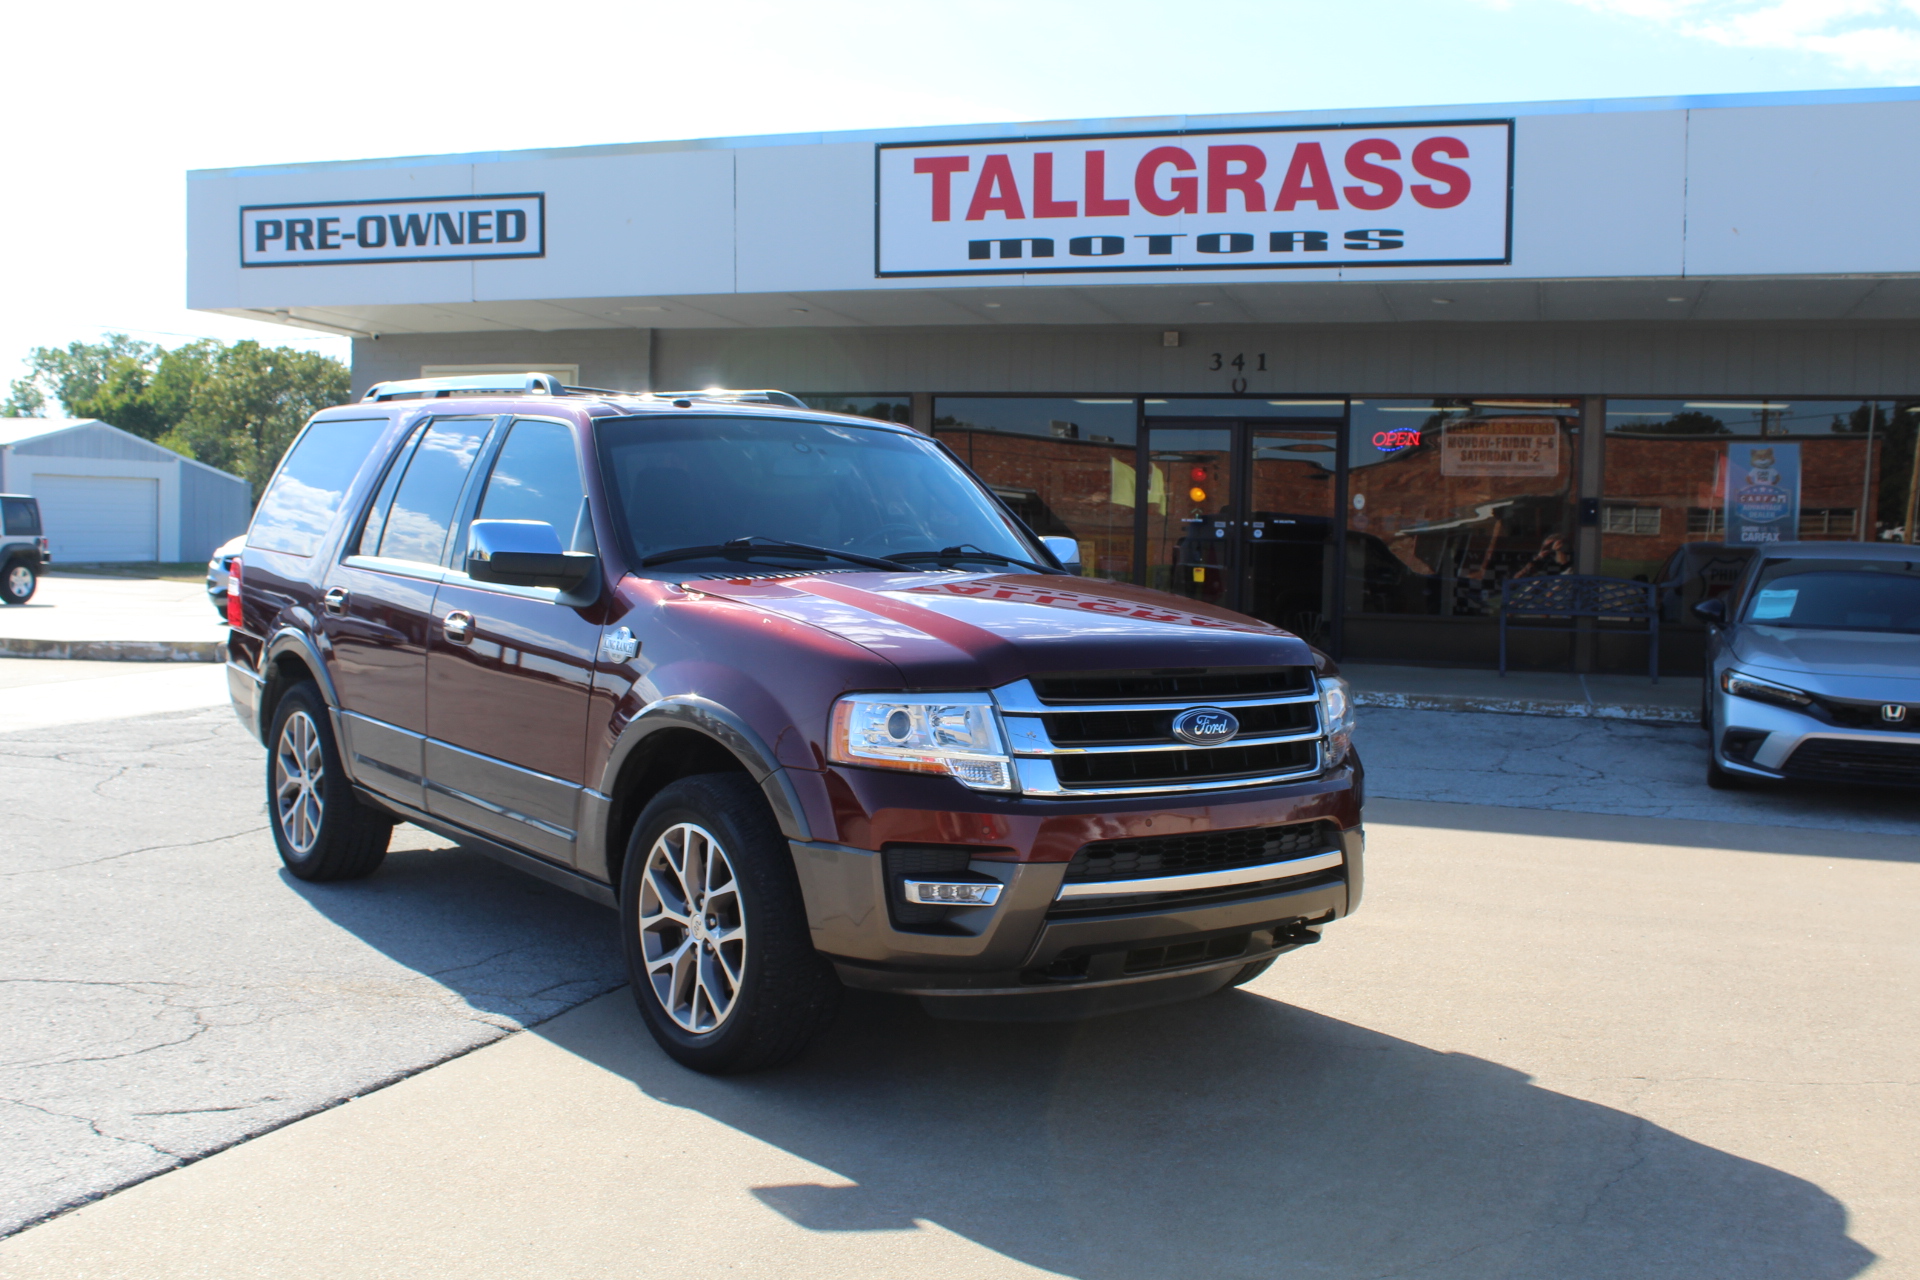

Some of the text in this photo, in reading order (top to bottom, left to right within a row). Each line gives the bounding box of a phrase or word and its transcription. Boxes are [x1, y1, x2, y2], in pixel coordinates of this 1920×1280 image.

[912, 136, 1472, 222] TALLGRASS
[254, 208, 528, 253] PRE-OWNED
[968, 228, 1405, 260] MOTORS
[1372, 431, 1421, 447] OPEN
[1460, 450, 1513, 462] SATURDAY
[1741, 532, 1780, 542] CARFAX
[1194, 714, 1228, 736] Ford
